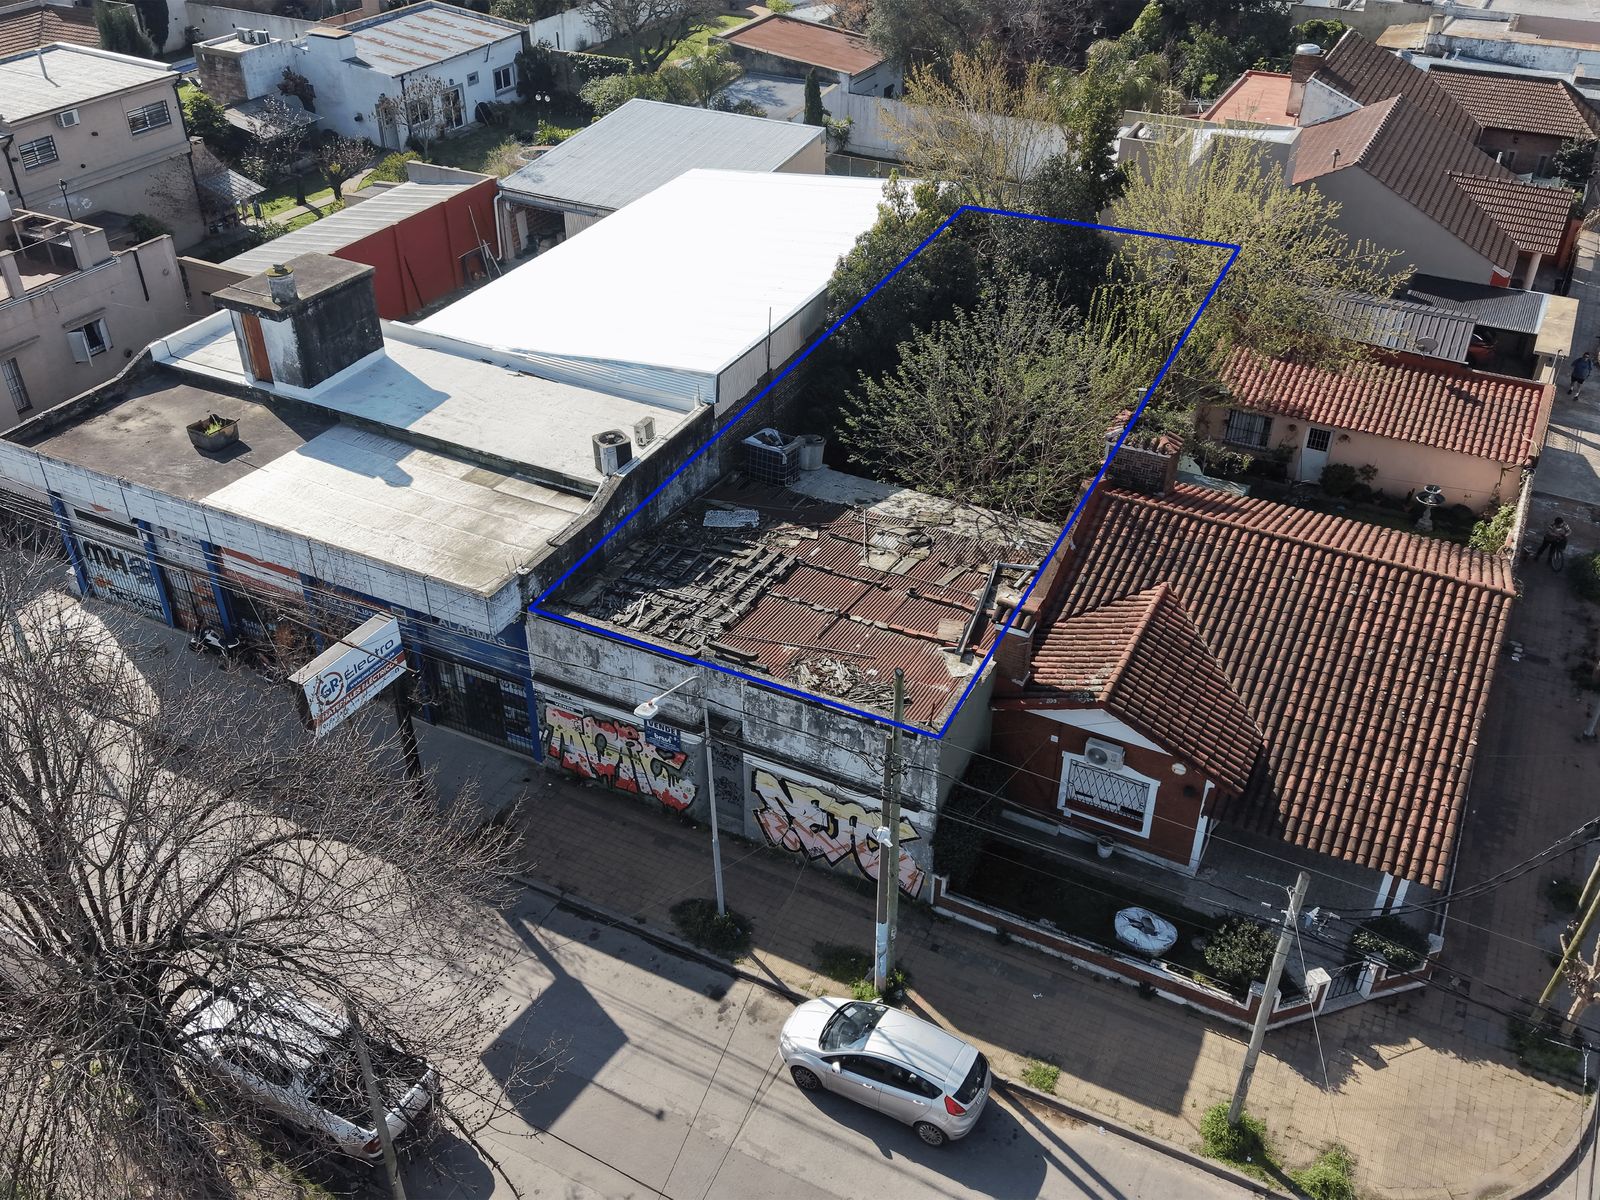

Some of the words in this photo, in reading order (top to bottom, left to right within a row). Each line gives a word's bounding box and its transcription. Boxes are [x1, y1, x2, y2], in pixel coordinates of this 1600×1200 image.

[438, 618, 507, 646] ALARMAS
[321, 678, 340, 698] GR
[646, 720, 677, 736] VENDE
